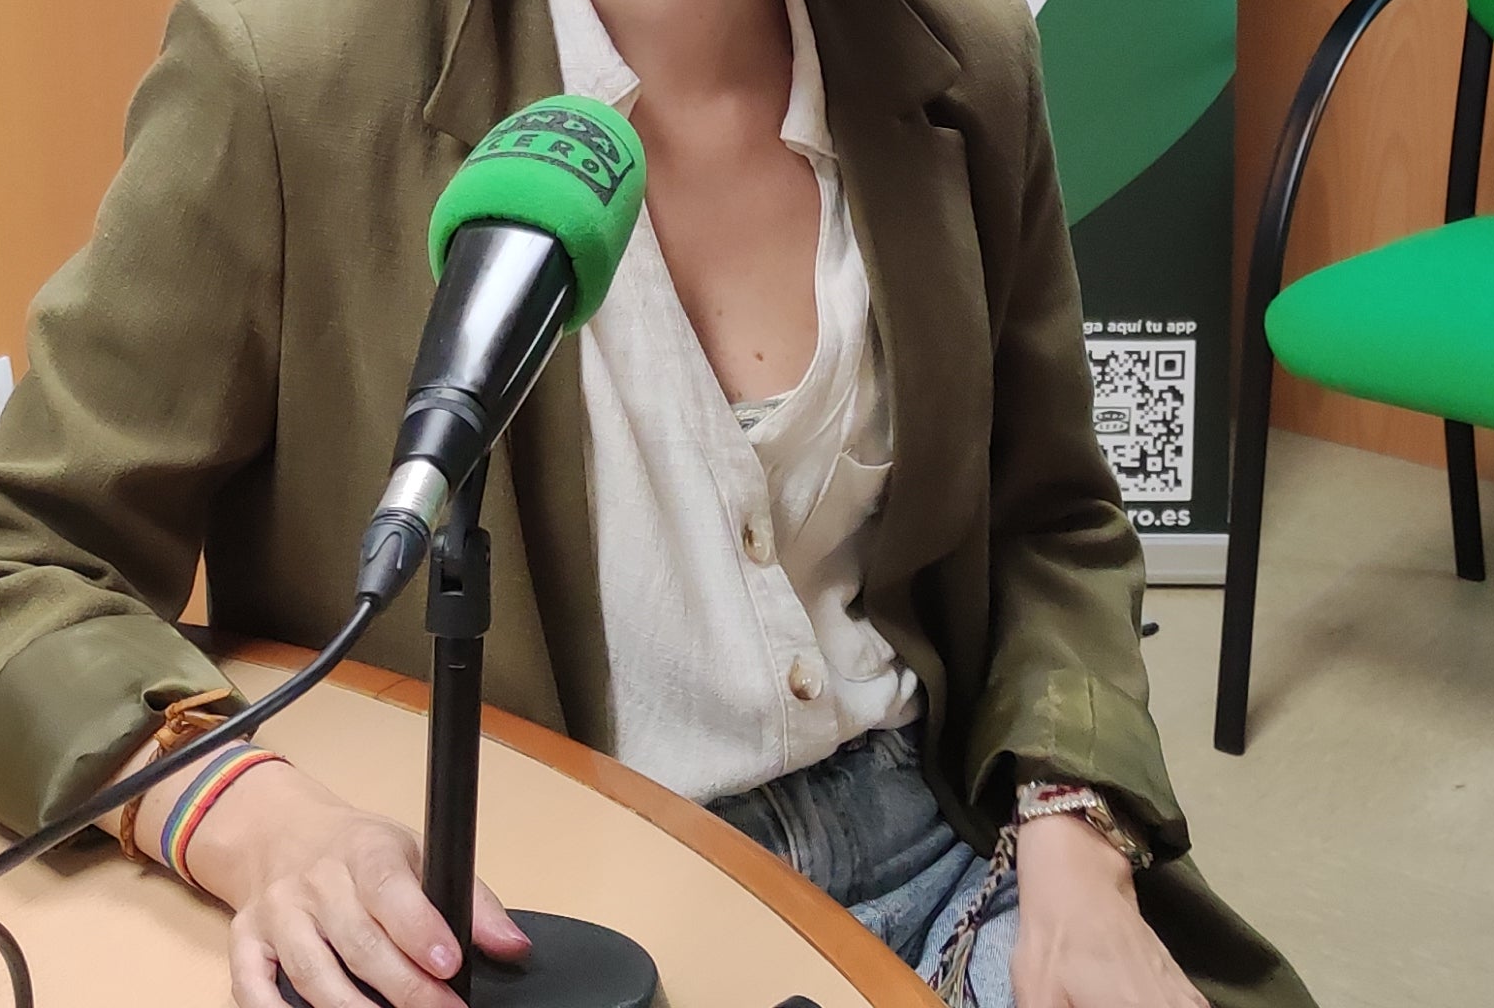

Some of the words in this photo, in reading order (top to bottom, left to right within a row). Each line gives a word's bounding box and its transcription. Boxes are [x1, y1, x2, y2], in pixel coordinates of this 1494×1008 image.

[1107, 319, 1143, 336] aquí
[1145, 320, 1163, 334] tu
[1166, 321, 1198, 336] app
